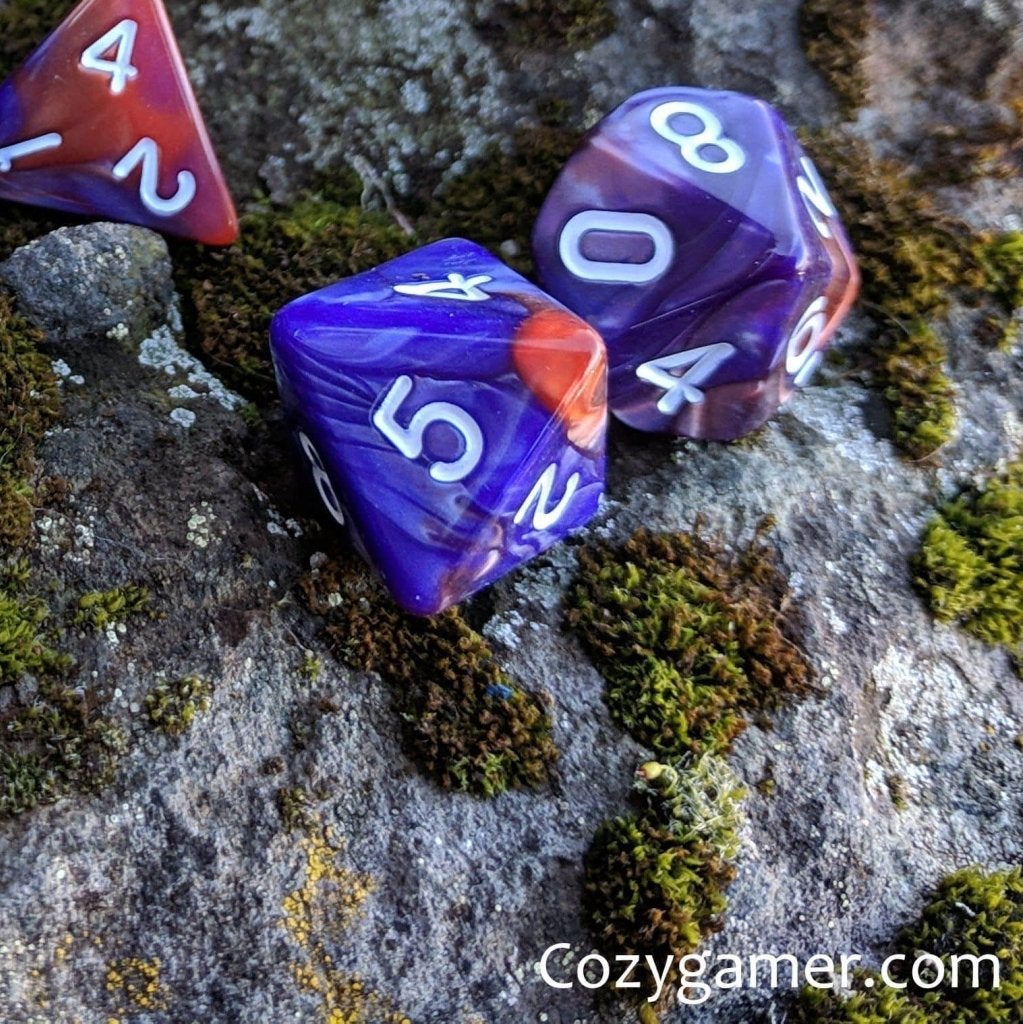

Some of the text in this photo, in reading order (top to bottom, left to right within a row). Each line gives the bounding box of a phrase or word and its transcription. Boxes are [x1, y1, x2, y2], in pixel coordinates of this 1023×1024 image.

[81, 19, 138, 95] 4
[649, 100, 746, 174] 8
[112, 136, 196, 217] 2
[559, 209, 673, 284] 0
[392, 272, 494, 302] 4
[635, 342, 737, 415] 4
[374, 375, 484, 482] 5
